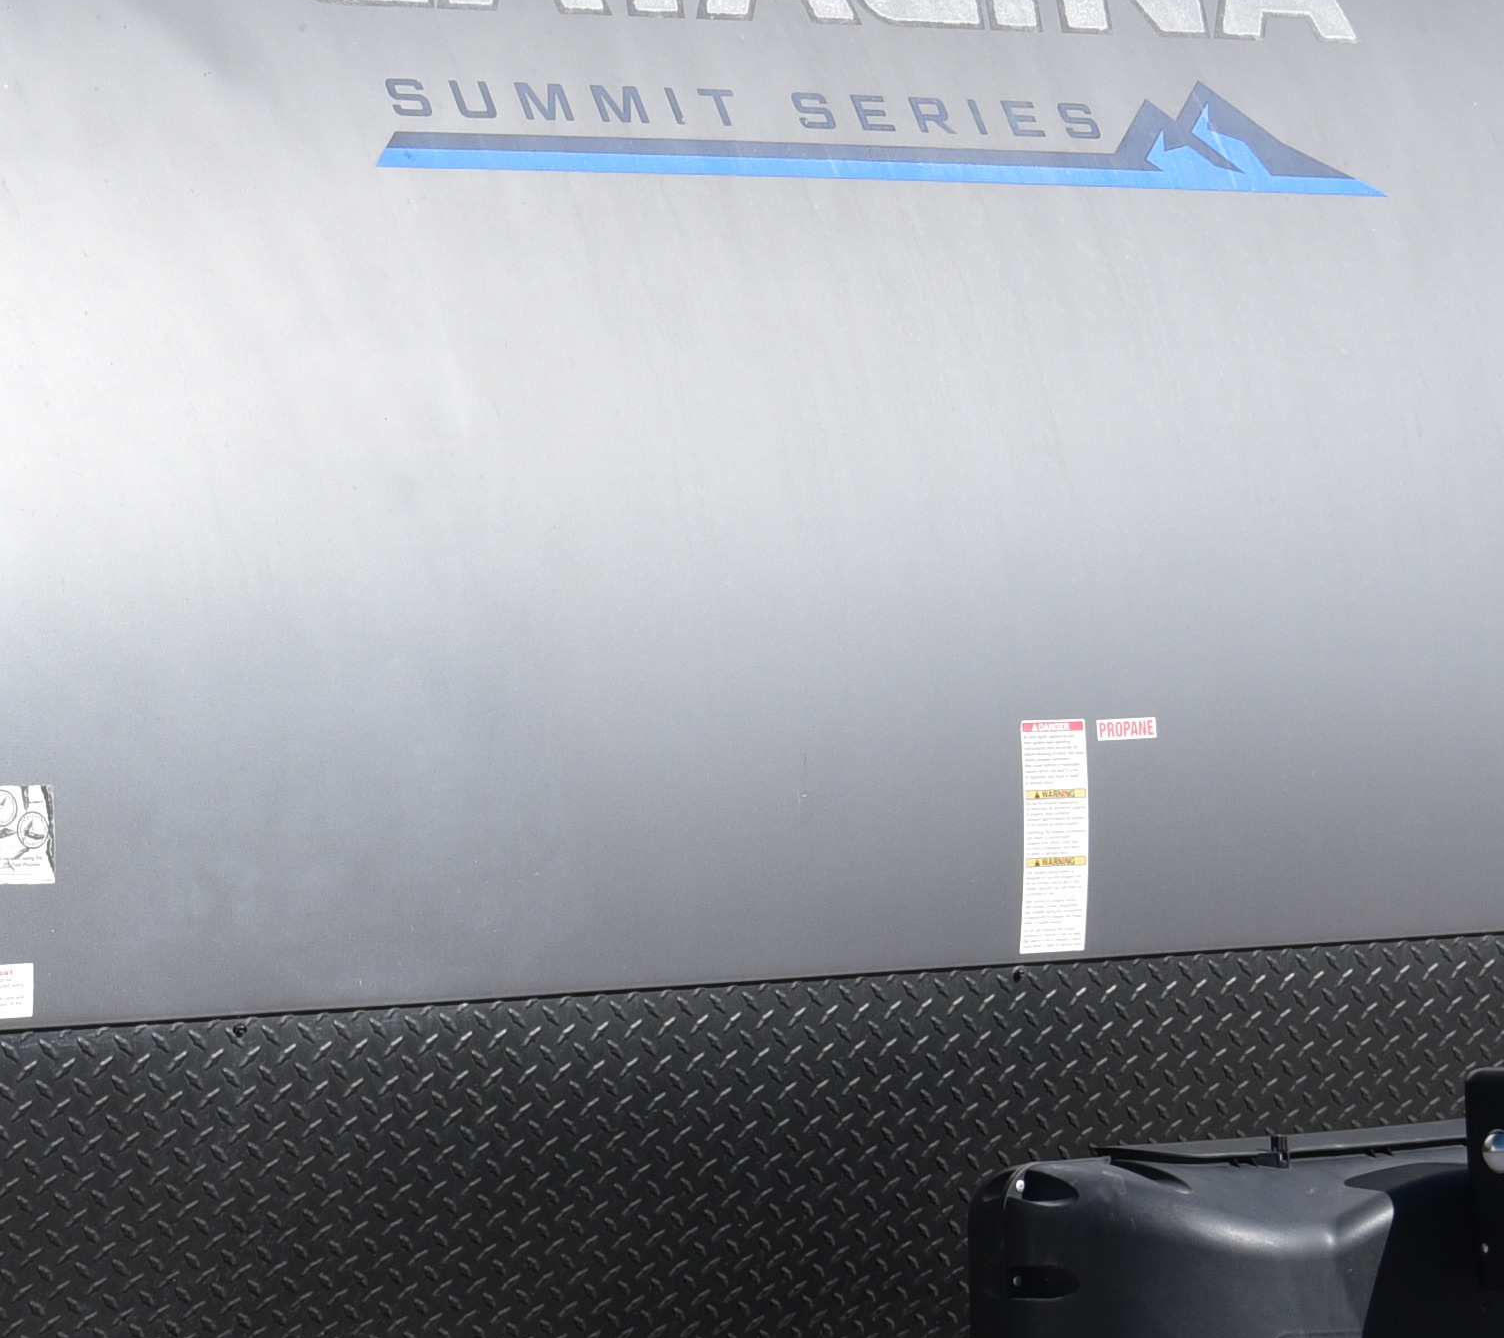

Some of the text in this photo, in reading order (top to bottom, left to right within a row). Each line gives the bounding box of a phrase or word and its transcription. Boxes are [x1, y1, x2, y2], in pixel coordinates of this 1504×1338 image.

[390, 77, 1101, 140] SUMMIT SERIES
[1038, 722, 1070, 731] DANGER
[1098, 719, 1155, 738] PROPANE
[1041, 789, 1076, 798] WARNING
